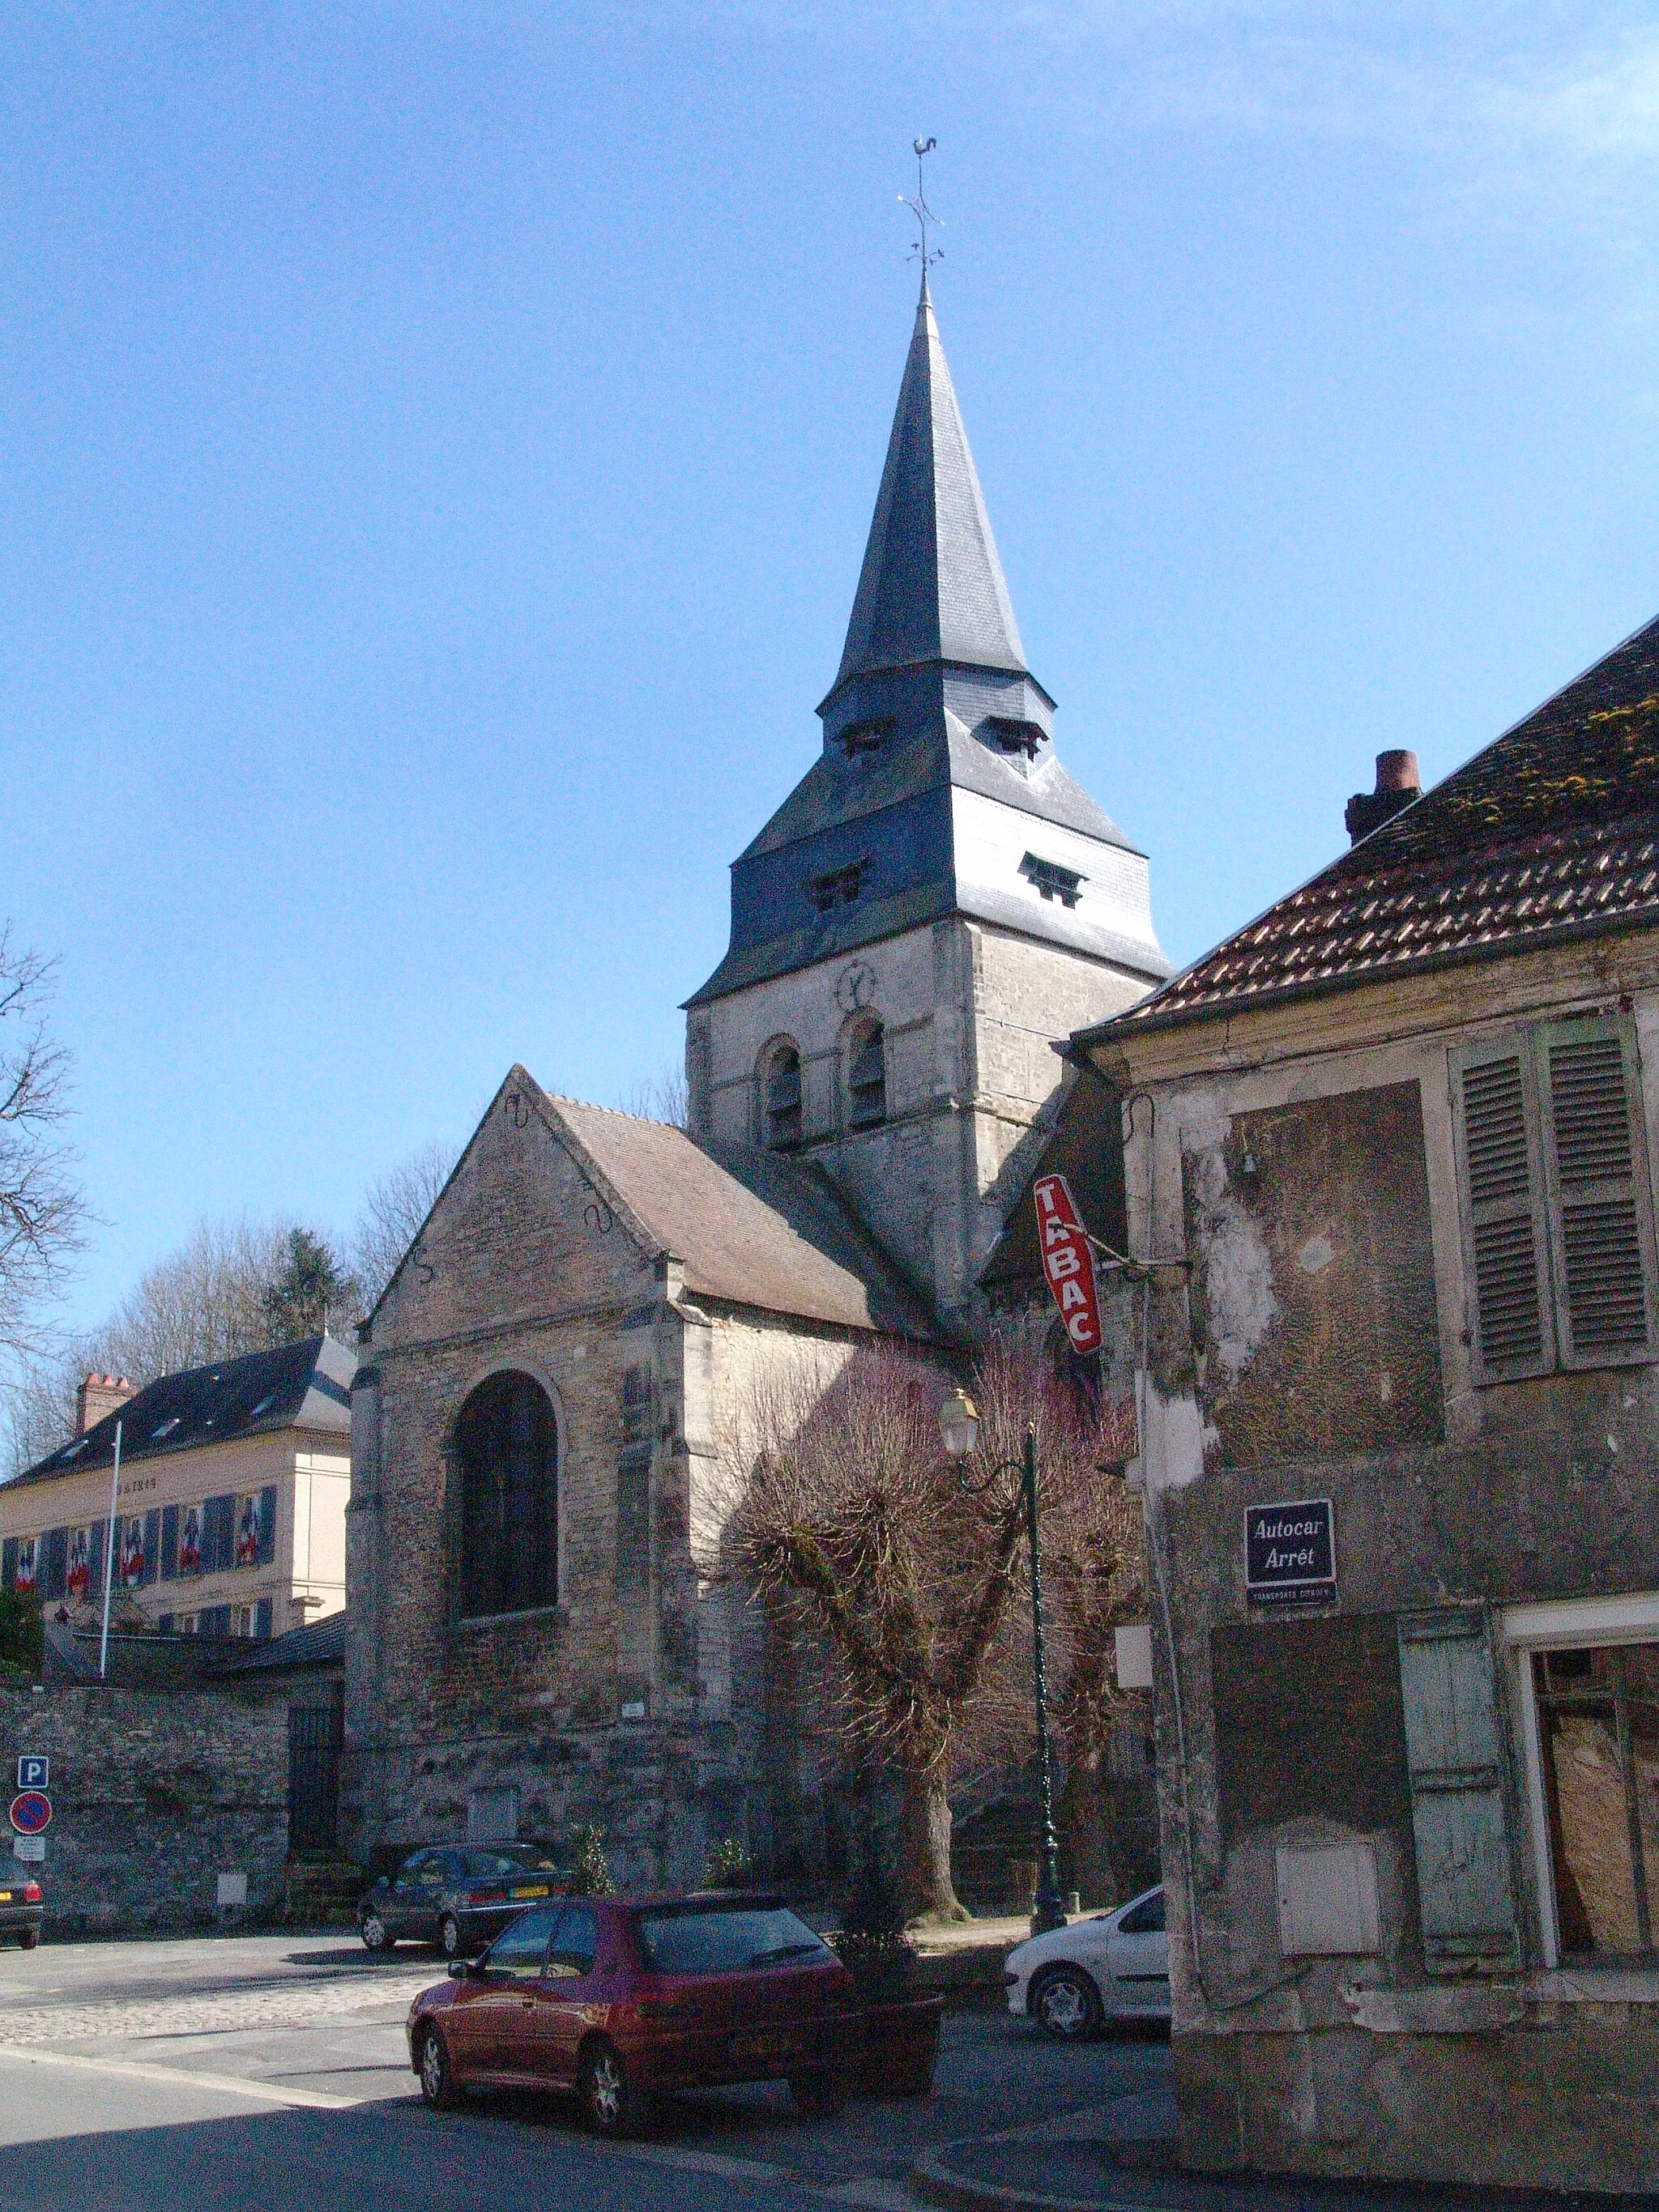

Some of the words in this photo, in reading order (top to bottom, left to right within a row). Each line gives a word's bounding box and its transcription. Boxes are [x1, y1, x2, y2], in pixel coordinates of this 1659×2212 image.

[1036, 1183, 1093, 1341] TABAC
[1254, 1519, 1323, 1539] Autocar
[1265, 1548, 1315, 1568] Arrêt
[28, 1762, 41, 1782] P
